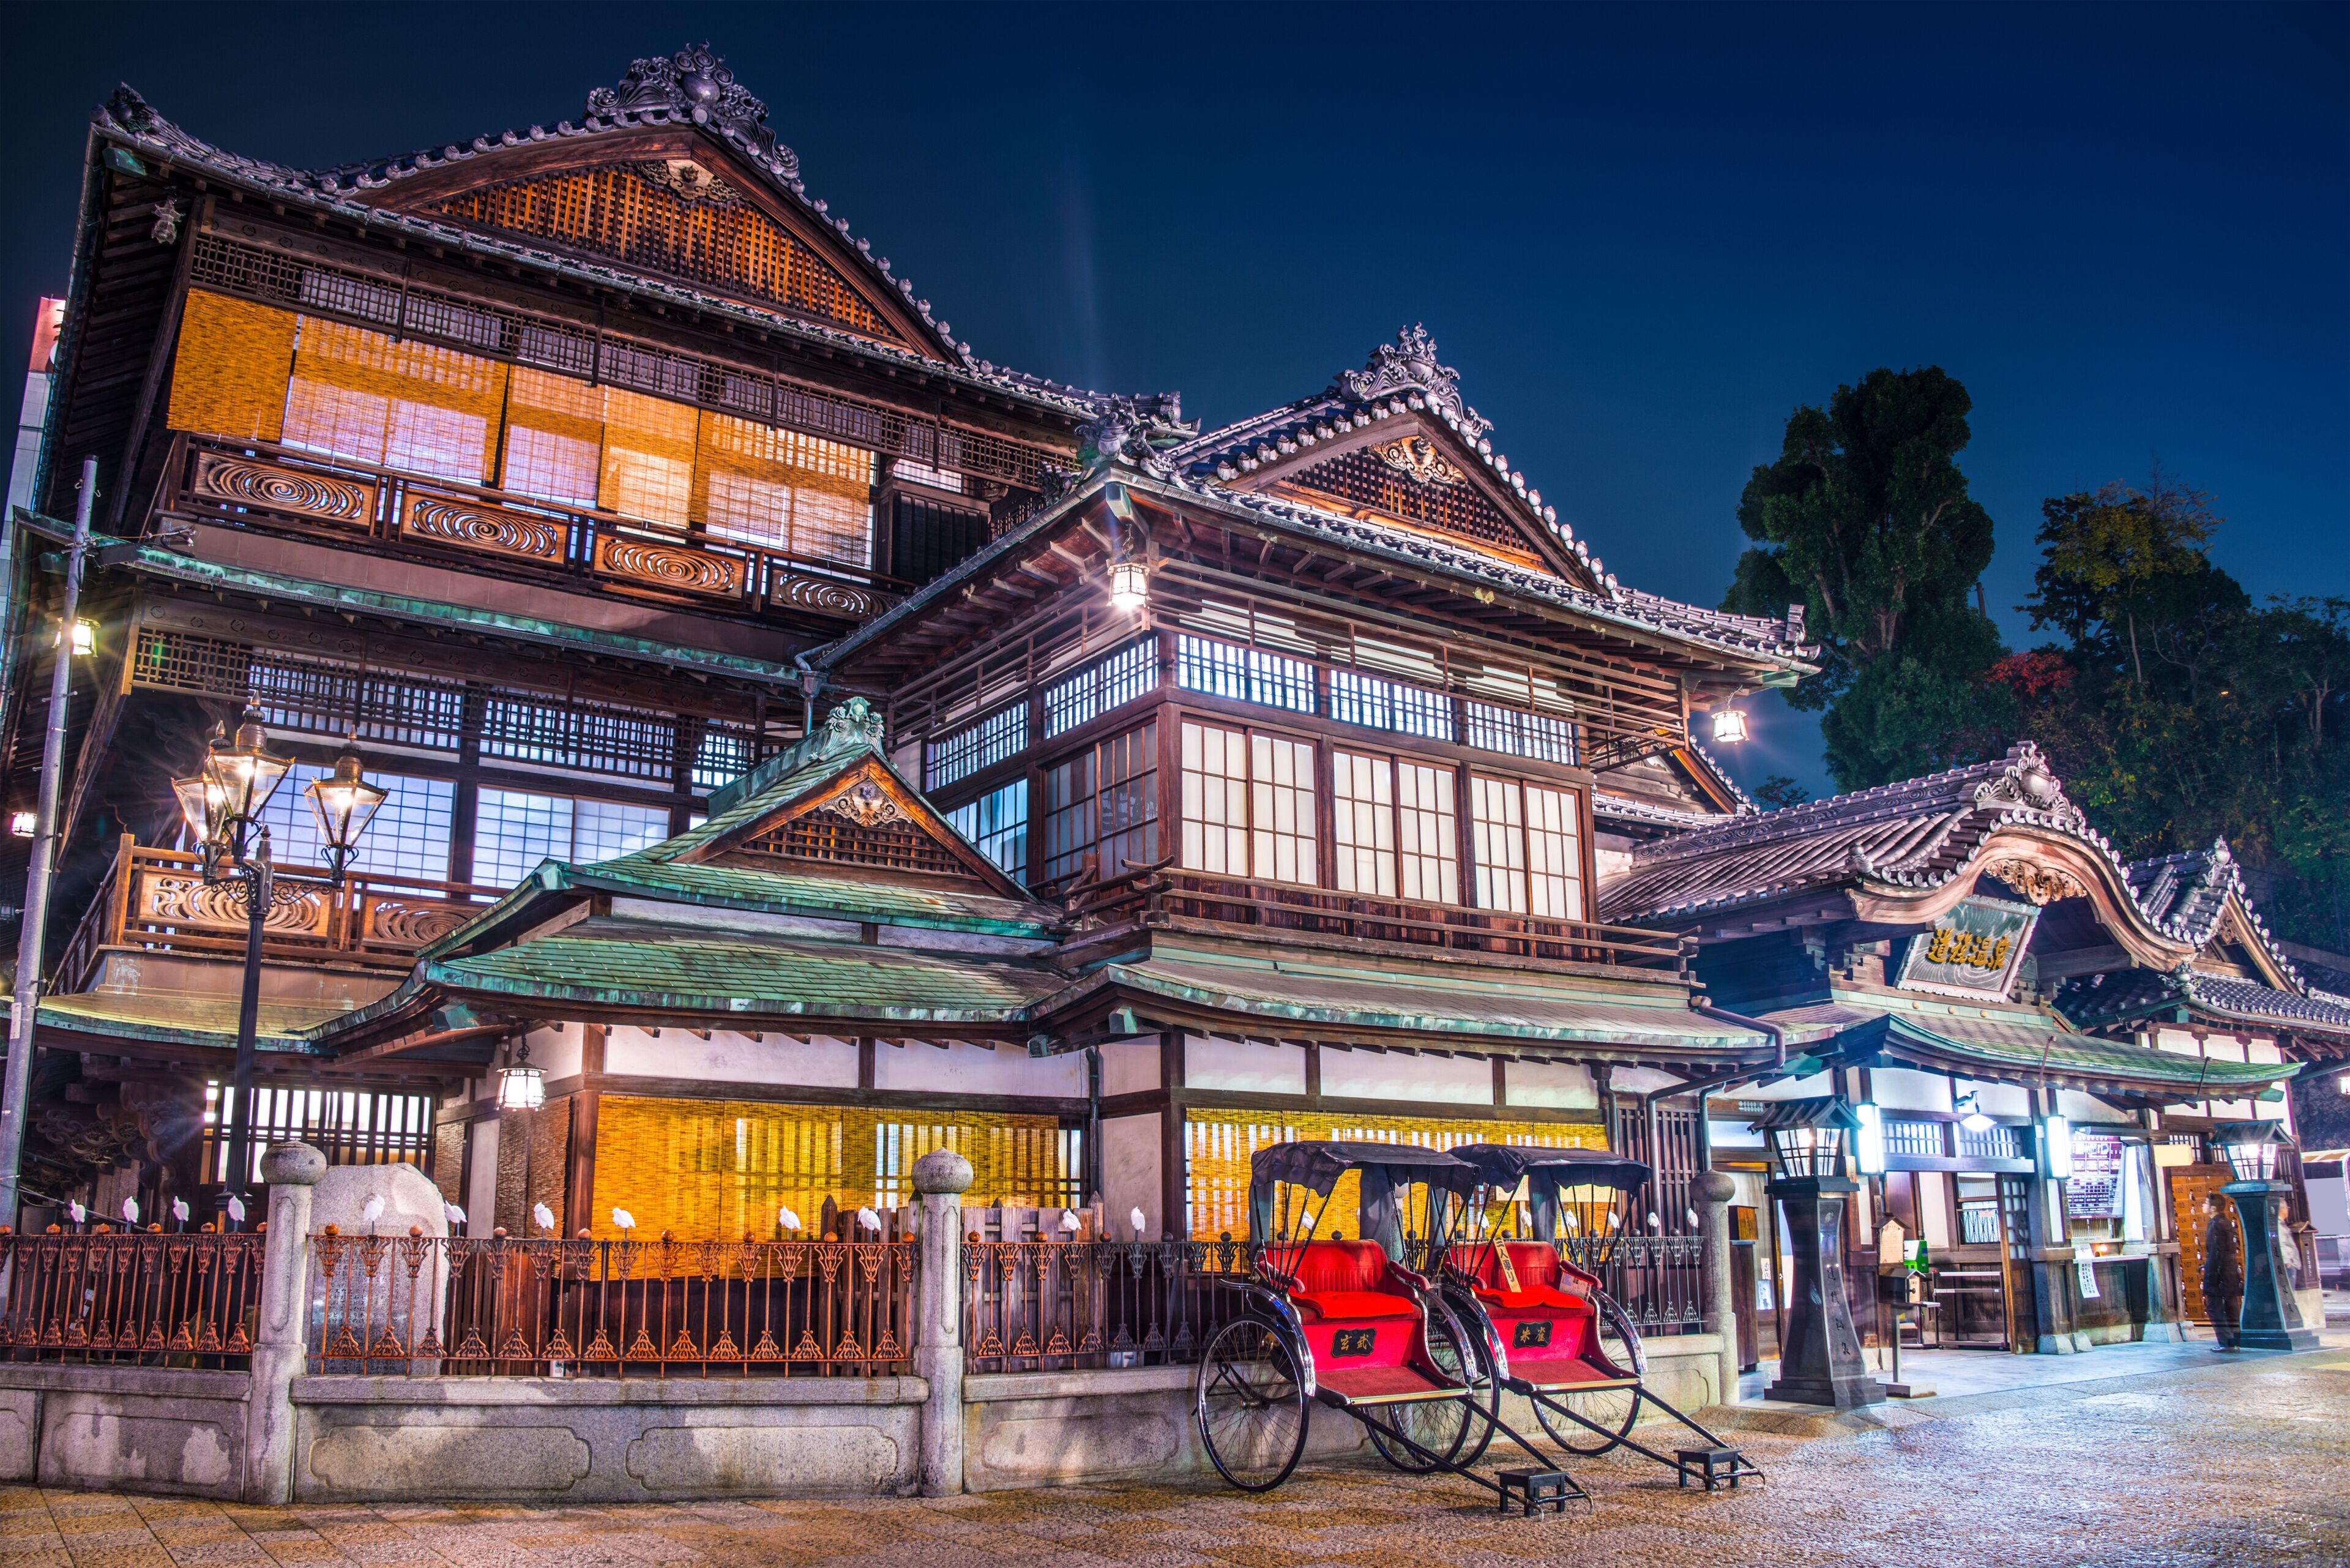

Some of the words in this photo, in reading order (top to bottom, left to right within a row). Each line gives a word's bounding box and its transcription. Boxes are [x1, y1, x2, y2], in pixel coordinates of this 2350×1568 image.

[1927, 927, 2010, 971] 道後温泉
[1340, 1334, 1373, 1351] 玄武
[1520, 1326, 1548, 1343] 朱雀
